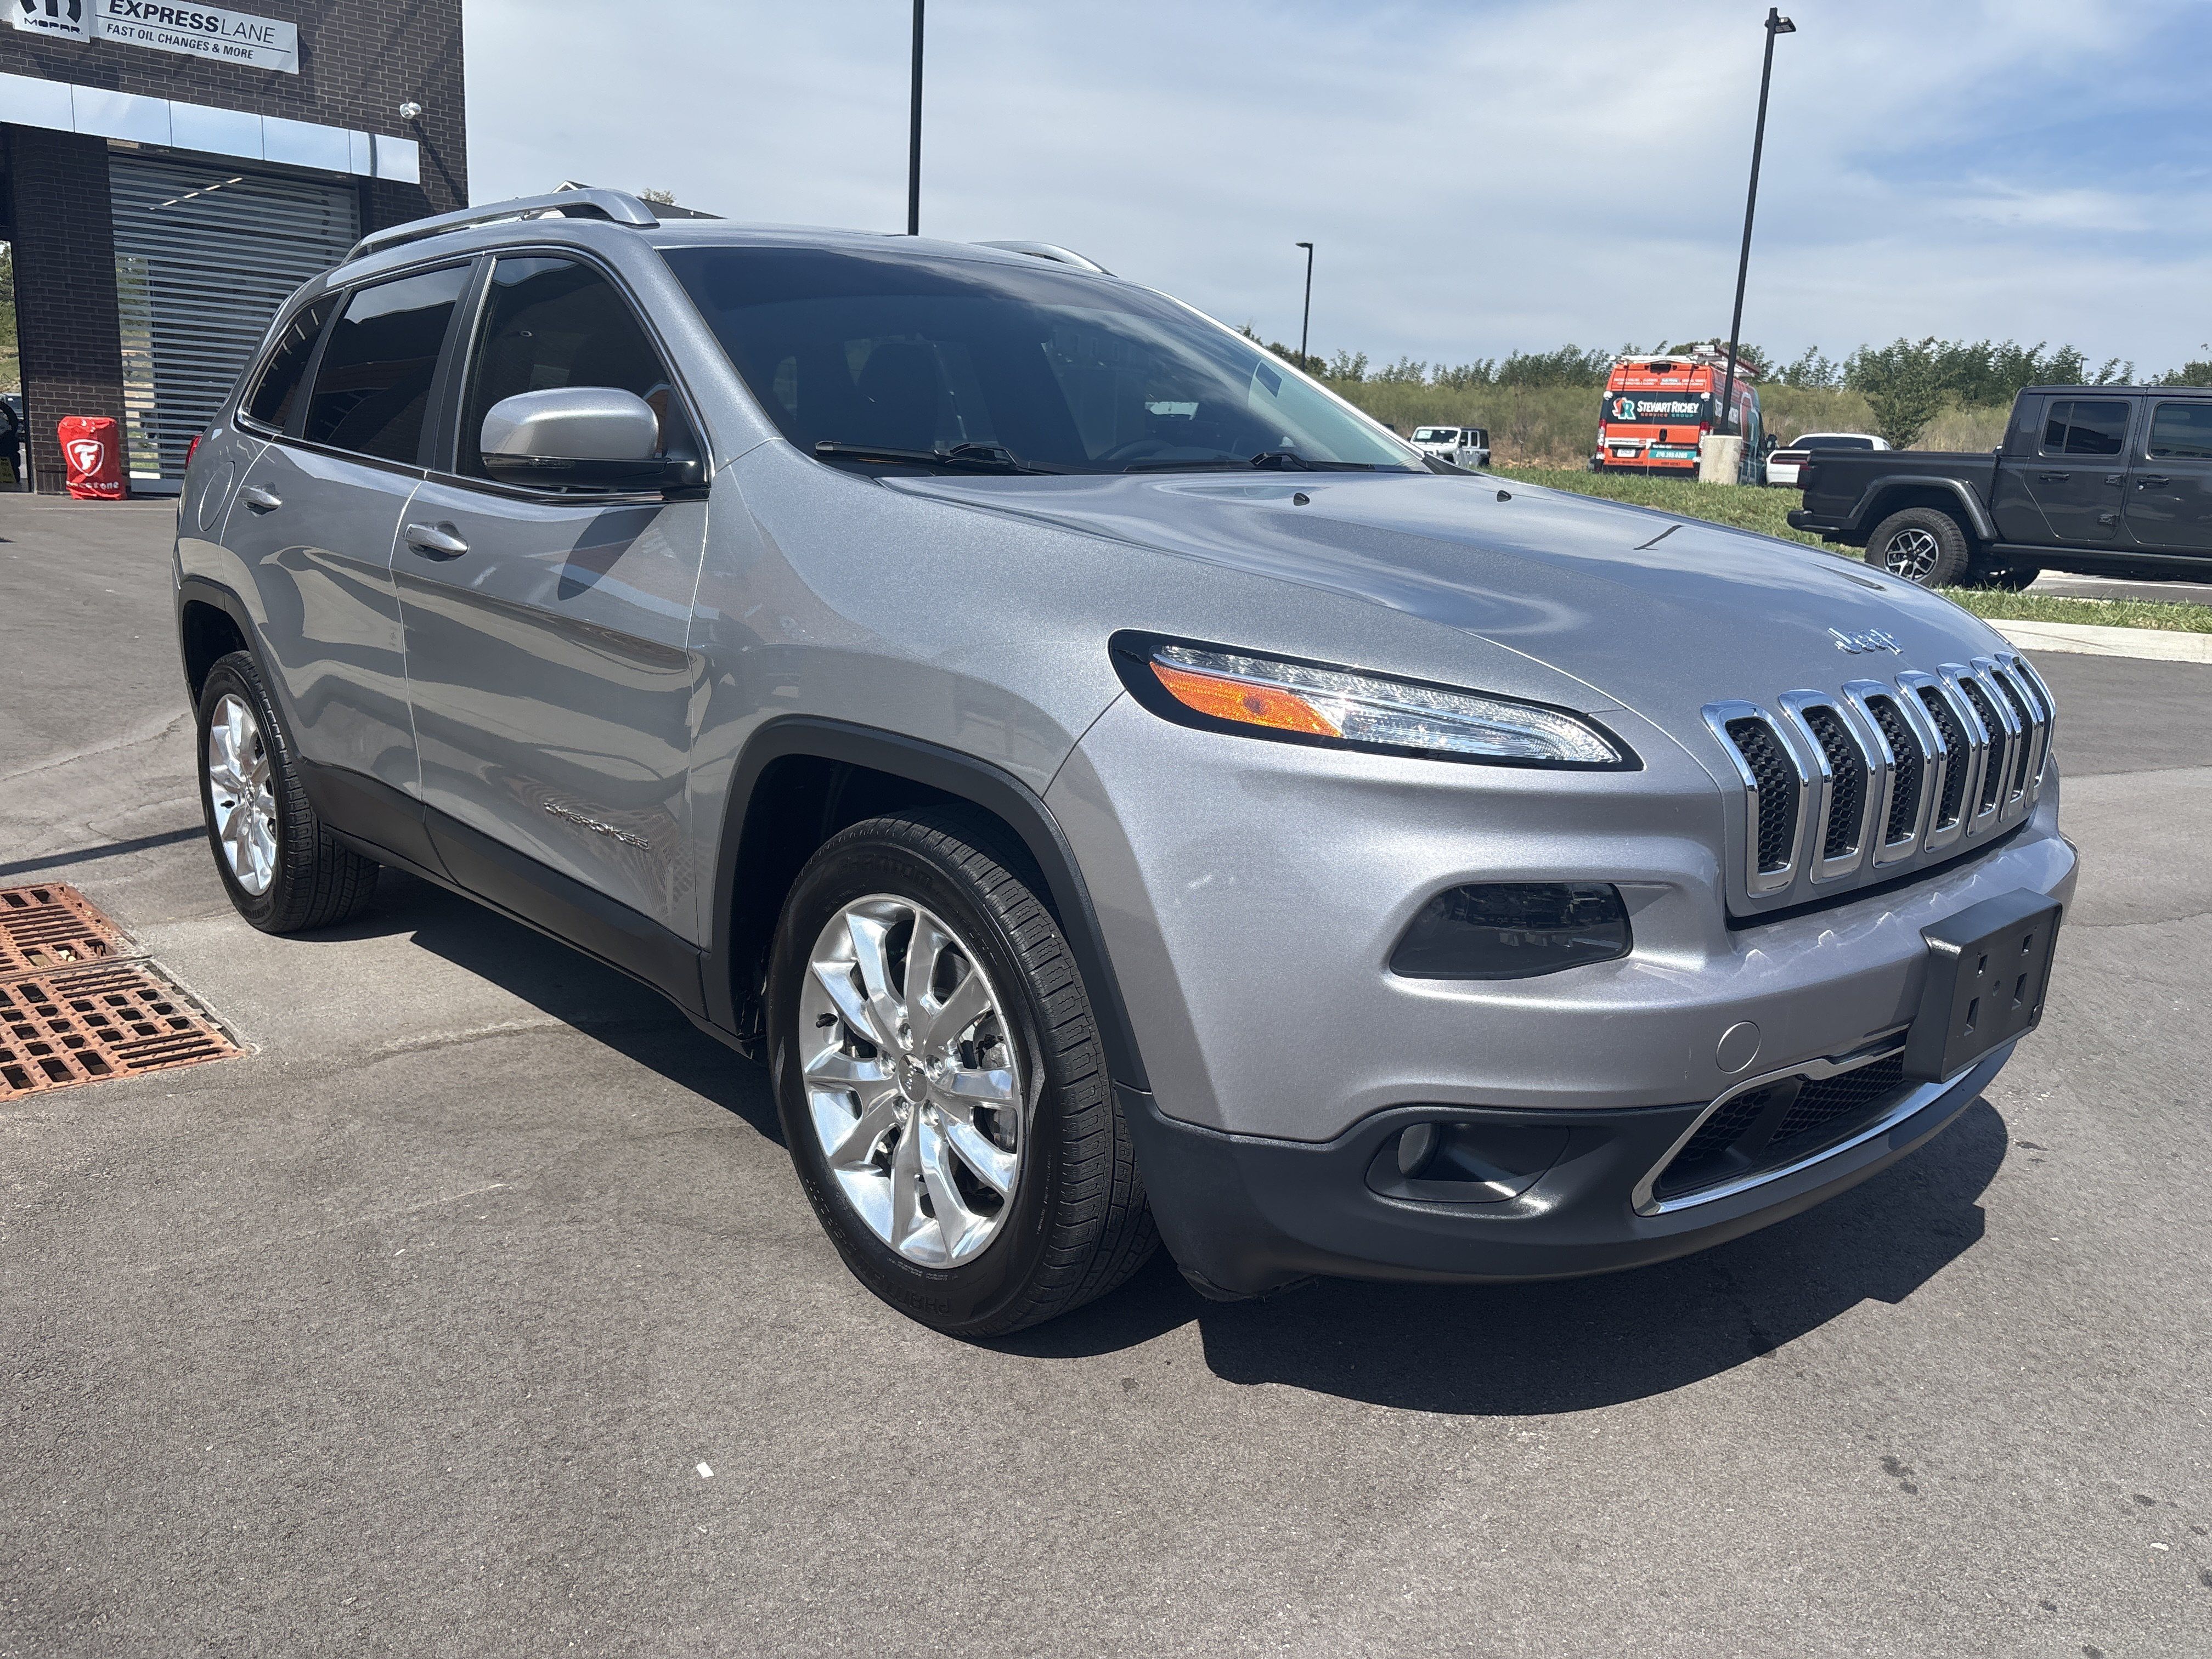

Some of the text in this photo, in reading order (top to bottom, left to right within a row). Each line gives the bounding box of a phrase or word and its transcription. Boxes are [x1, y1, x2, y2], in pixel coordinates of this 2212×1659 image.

[24, 18, 80, 34] MOPAR
[106, 23, 254, 59] FAST OIL CHANGES & MORE
[1827, 627, 1904, 656] Jeep
